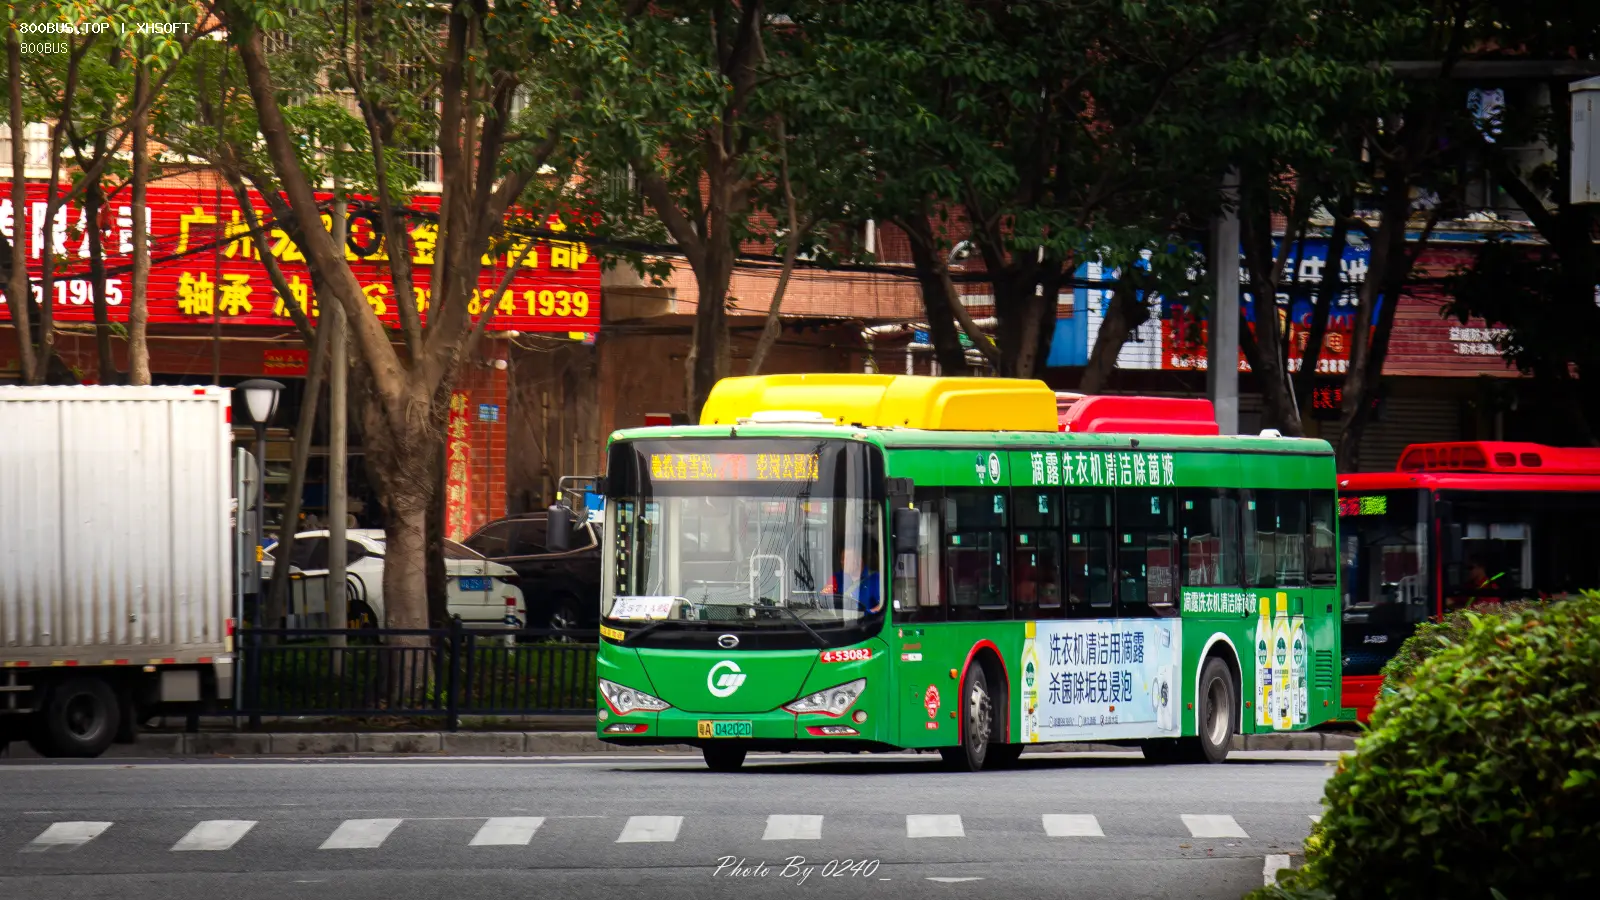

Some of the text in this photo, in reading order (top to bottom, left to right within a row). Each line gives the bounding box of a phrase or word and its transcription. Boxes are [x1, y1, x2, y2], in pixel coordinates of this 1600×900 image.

[178, 271, 253, 315] 轴承
[523, 289, 590, 317] 1939
[1030, 451, 1175, 486] 滴露洗衣机清洁除菌液
[823, 648, 870, 662] 4-53082
[1049, 631, 1144, 666] 洗衣机清洁用滴露
[1049, 670, 1132, 705] 杀菌除垢免浸泡
